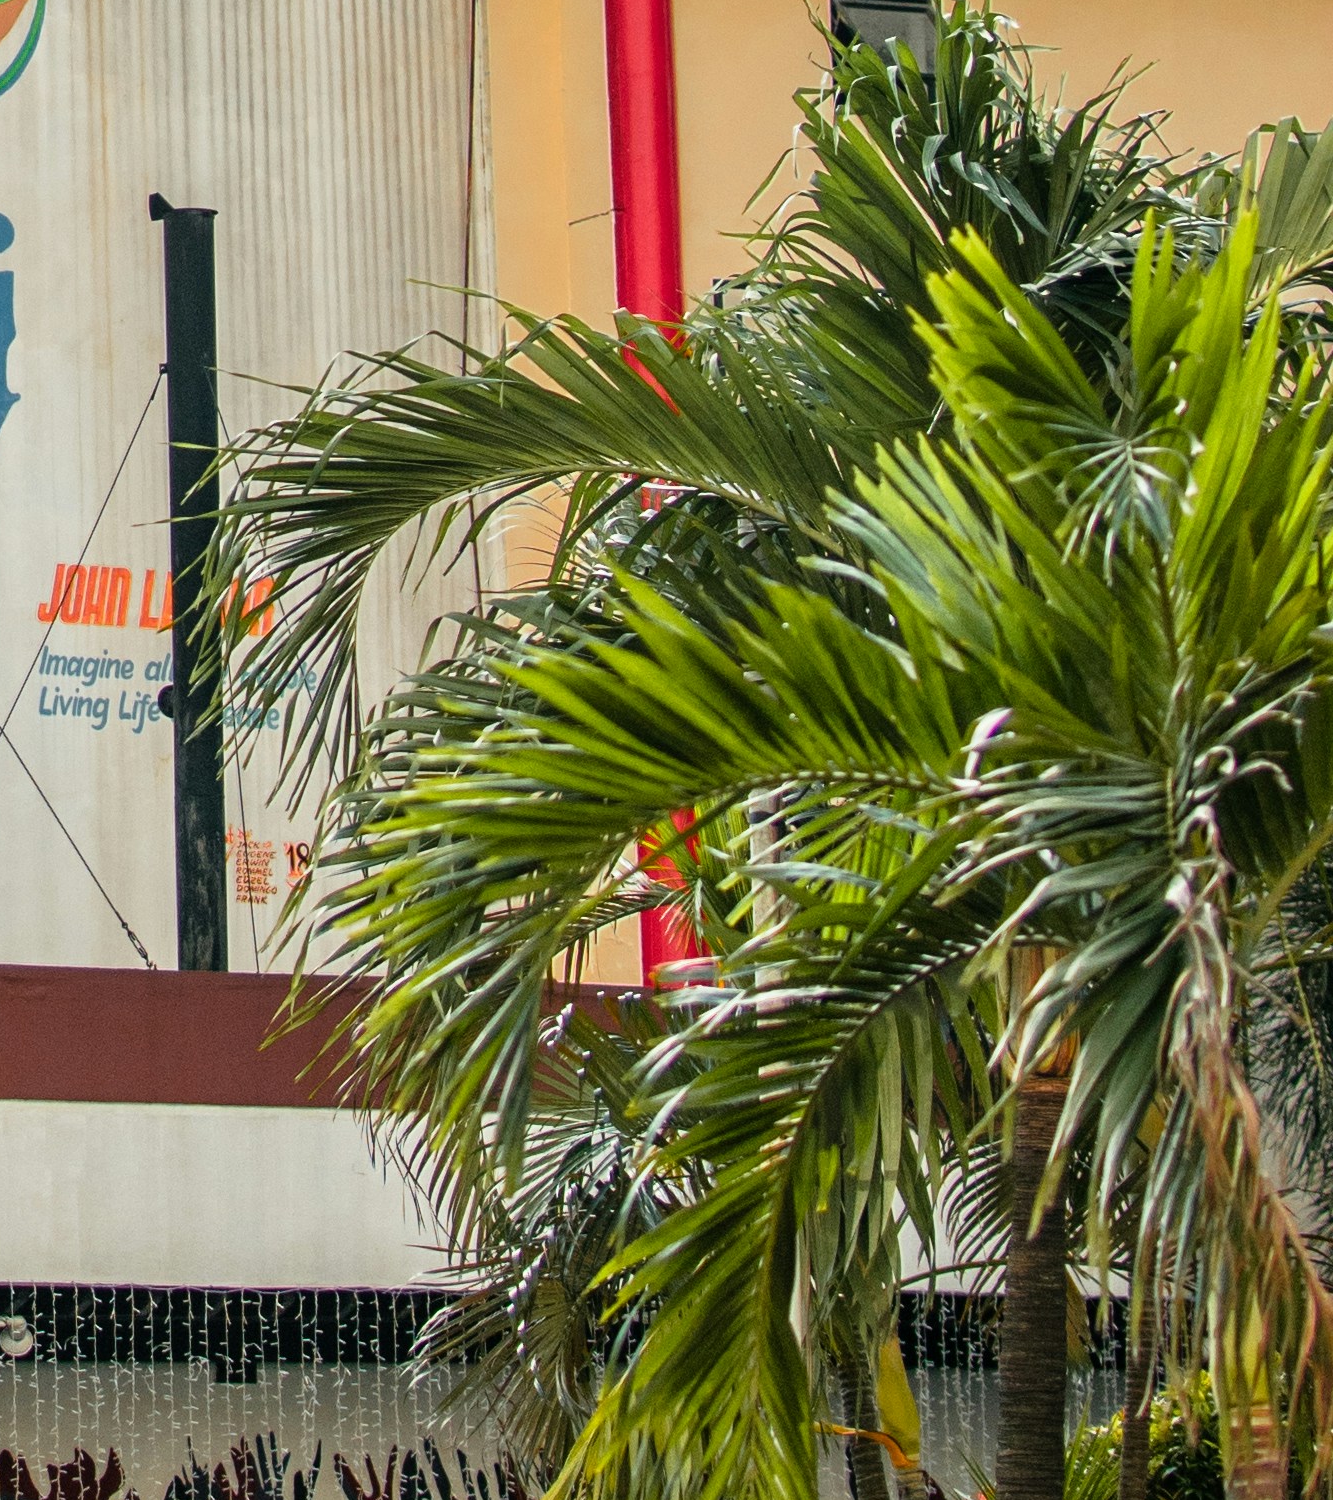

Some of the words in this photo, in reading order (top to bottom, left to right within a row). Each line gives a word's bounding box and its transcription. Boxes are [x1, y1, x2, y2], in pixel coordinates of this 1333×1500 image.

[37, 563, 131, 628] JOHN
[39, 645, 134, 687] Imagine
[38, 686, 110, 731] Living
[118, 690, 161, 734] Life
